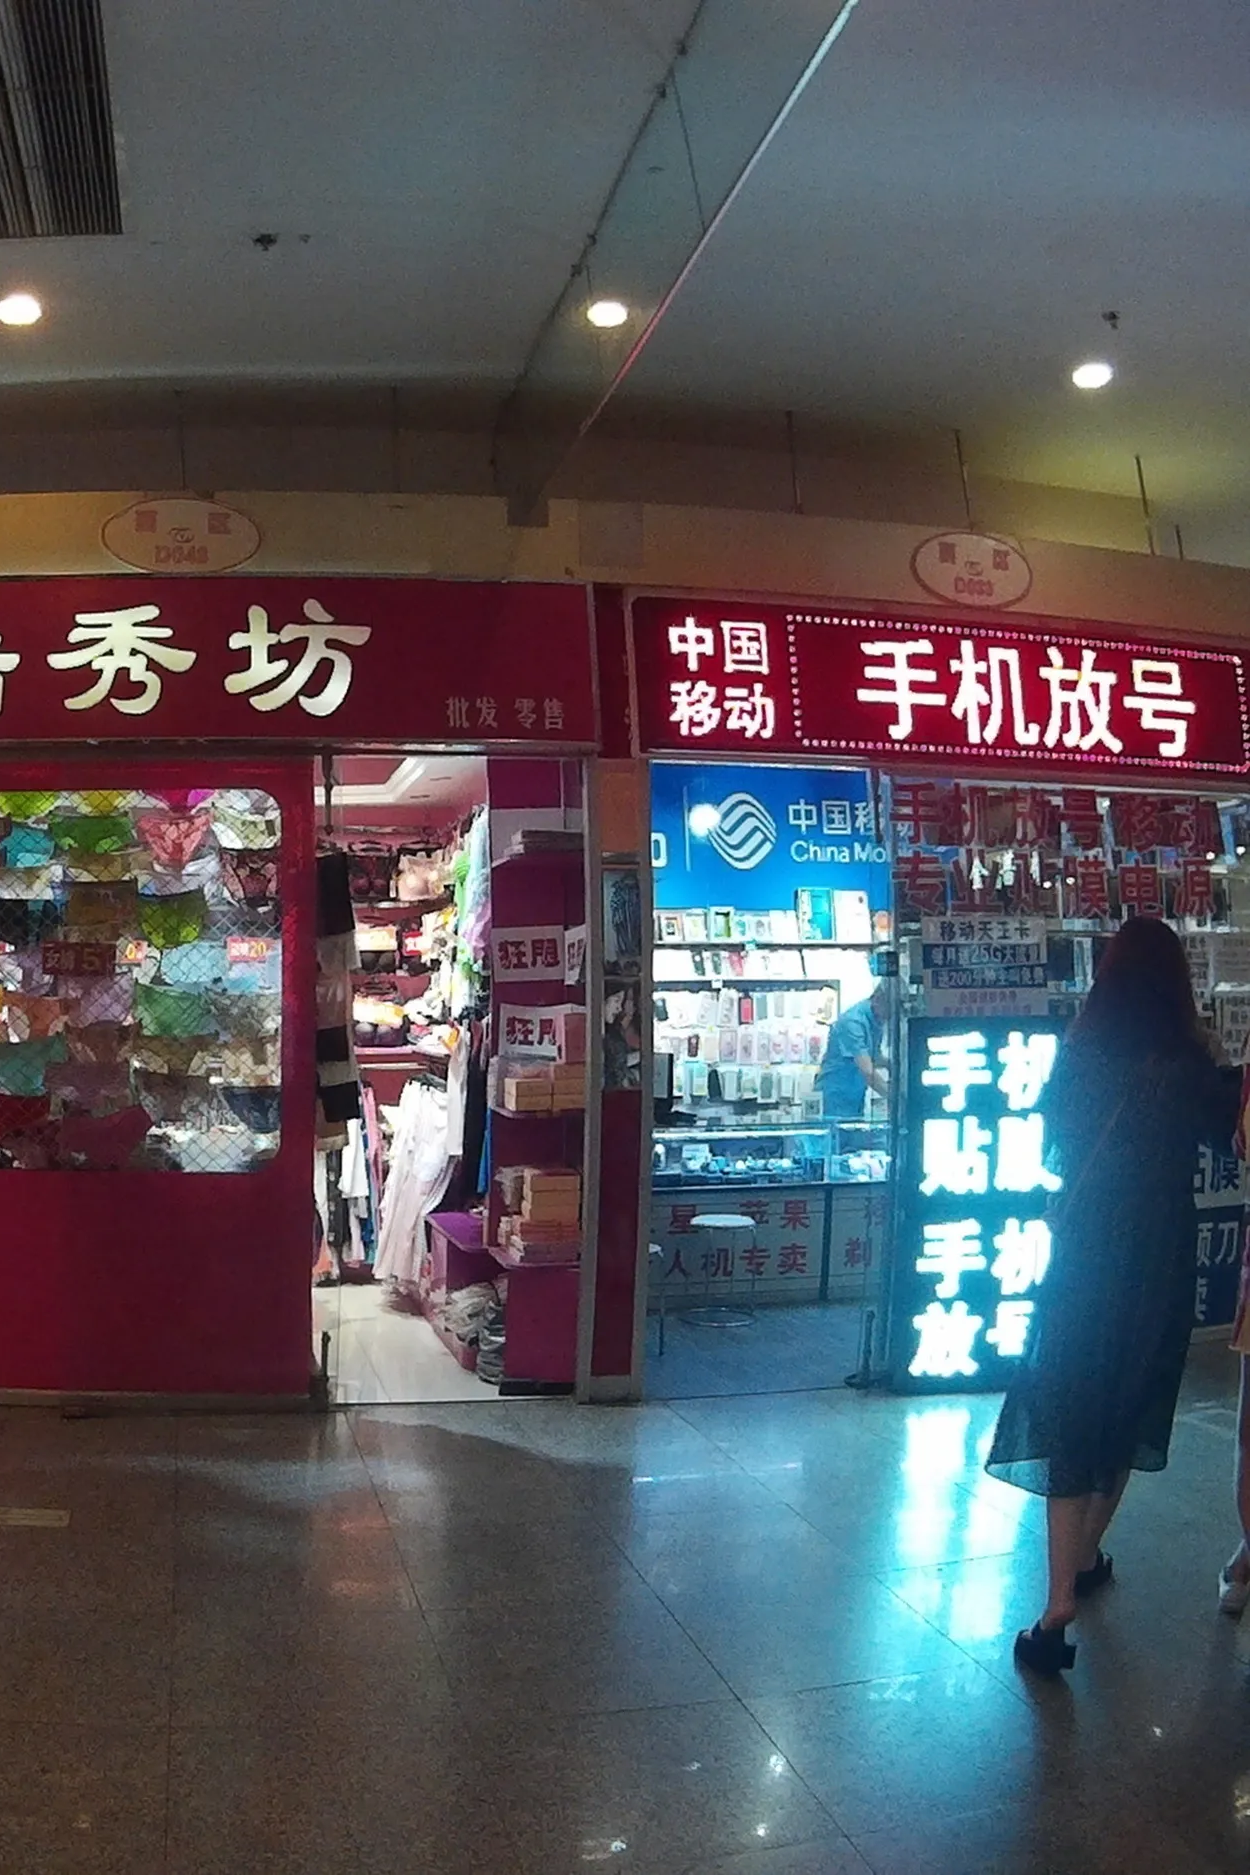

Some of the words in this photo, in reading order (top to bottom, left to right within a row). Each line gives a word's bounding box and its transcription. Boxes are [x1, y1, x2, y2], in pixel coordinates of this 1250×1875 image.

[667, 615, 771, 675] 中国
[445, 696, 498, 729] 批发
[513, 697, 565, 730] 零售
[669, 680, 776, 739] 移动
[856, 639, 1197, 757] 手机放号
[790, 840, 851, 864] China
[940, 919, 1031, 942] 移动天王卡
[921, 1031, 1058, 1113] 手机
[916, 1217, 1052, 1299] 手机
